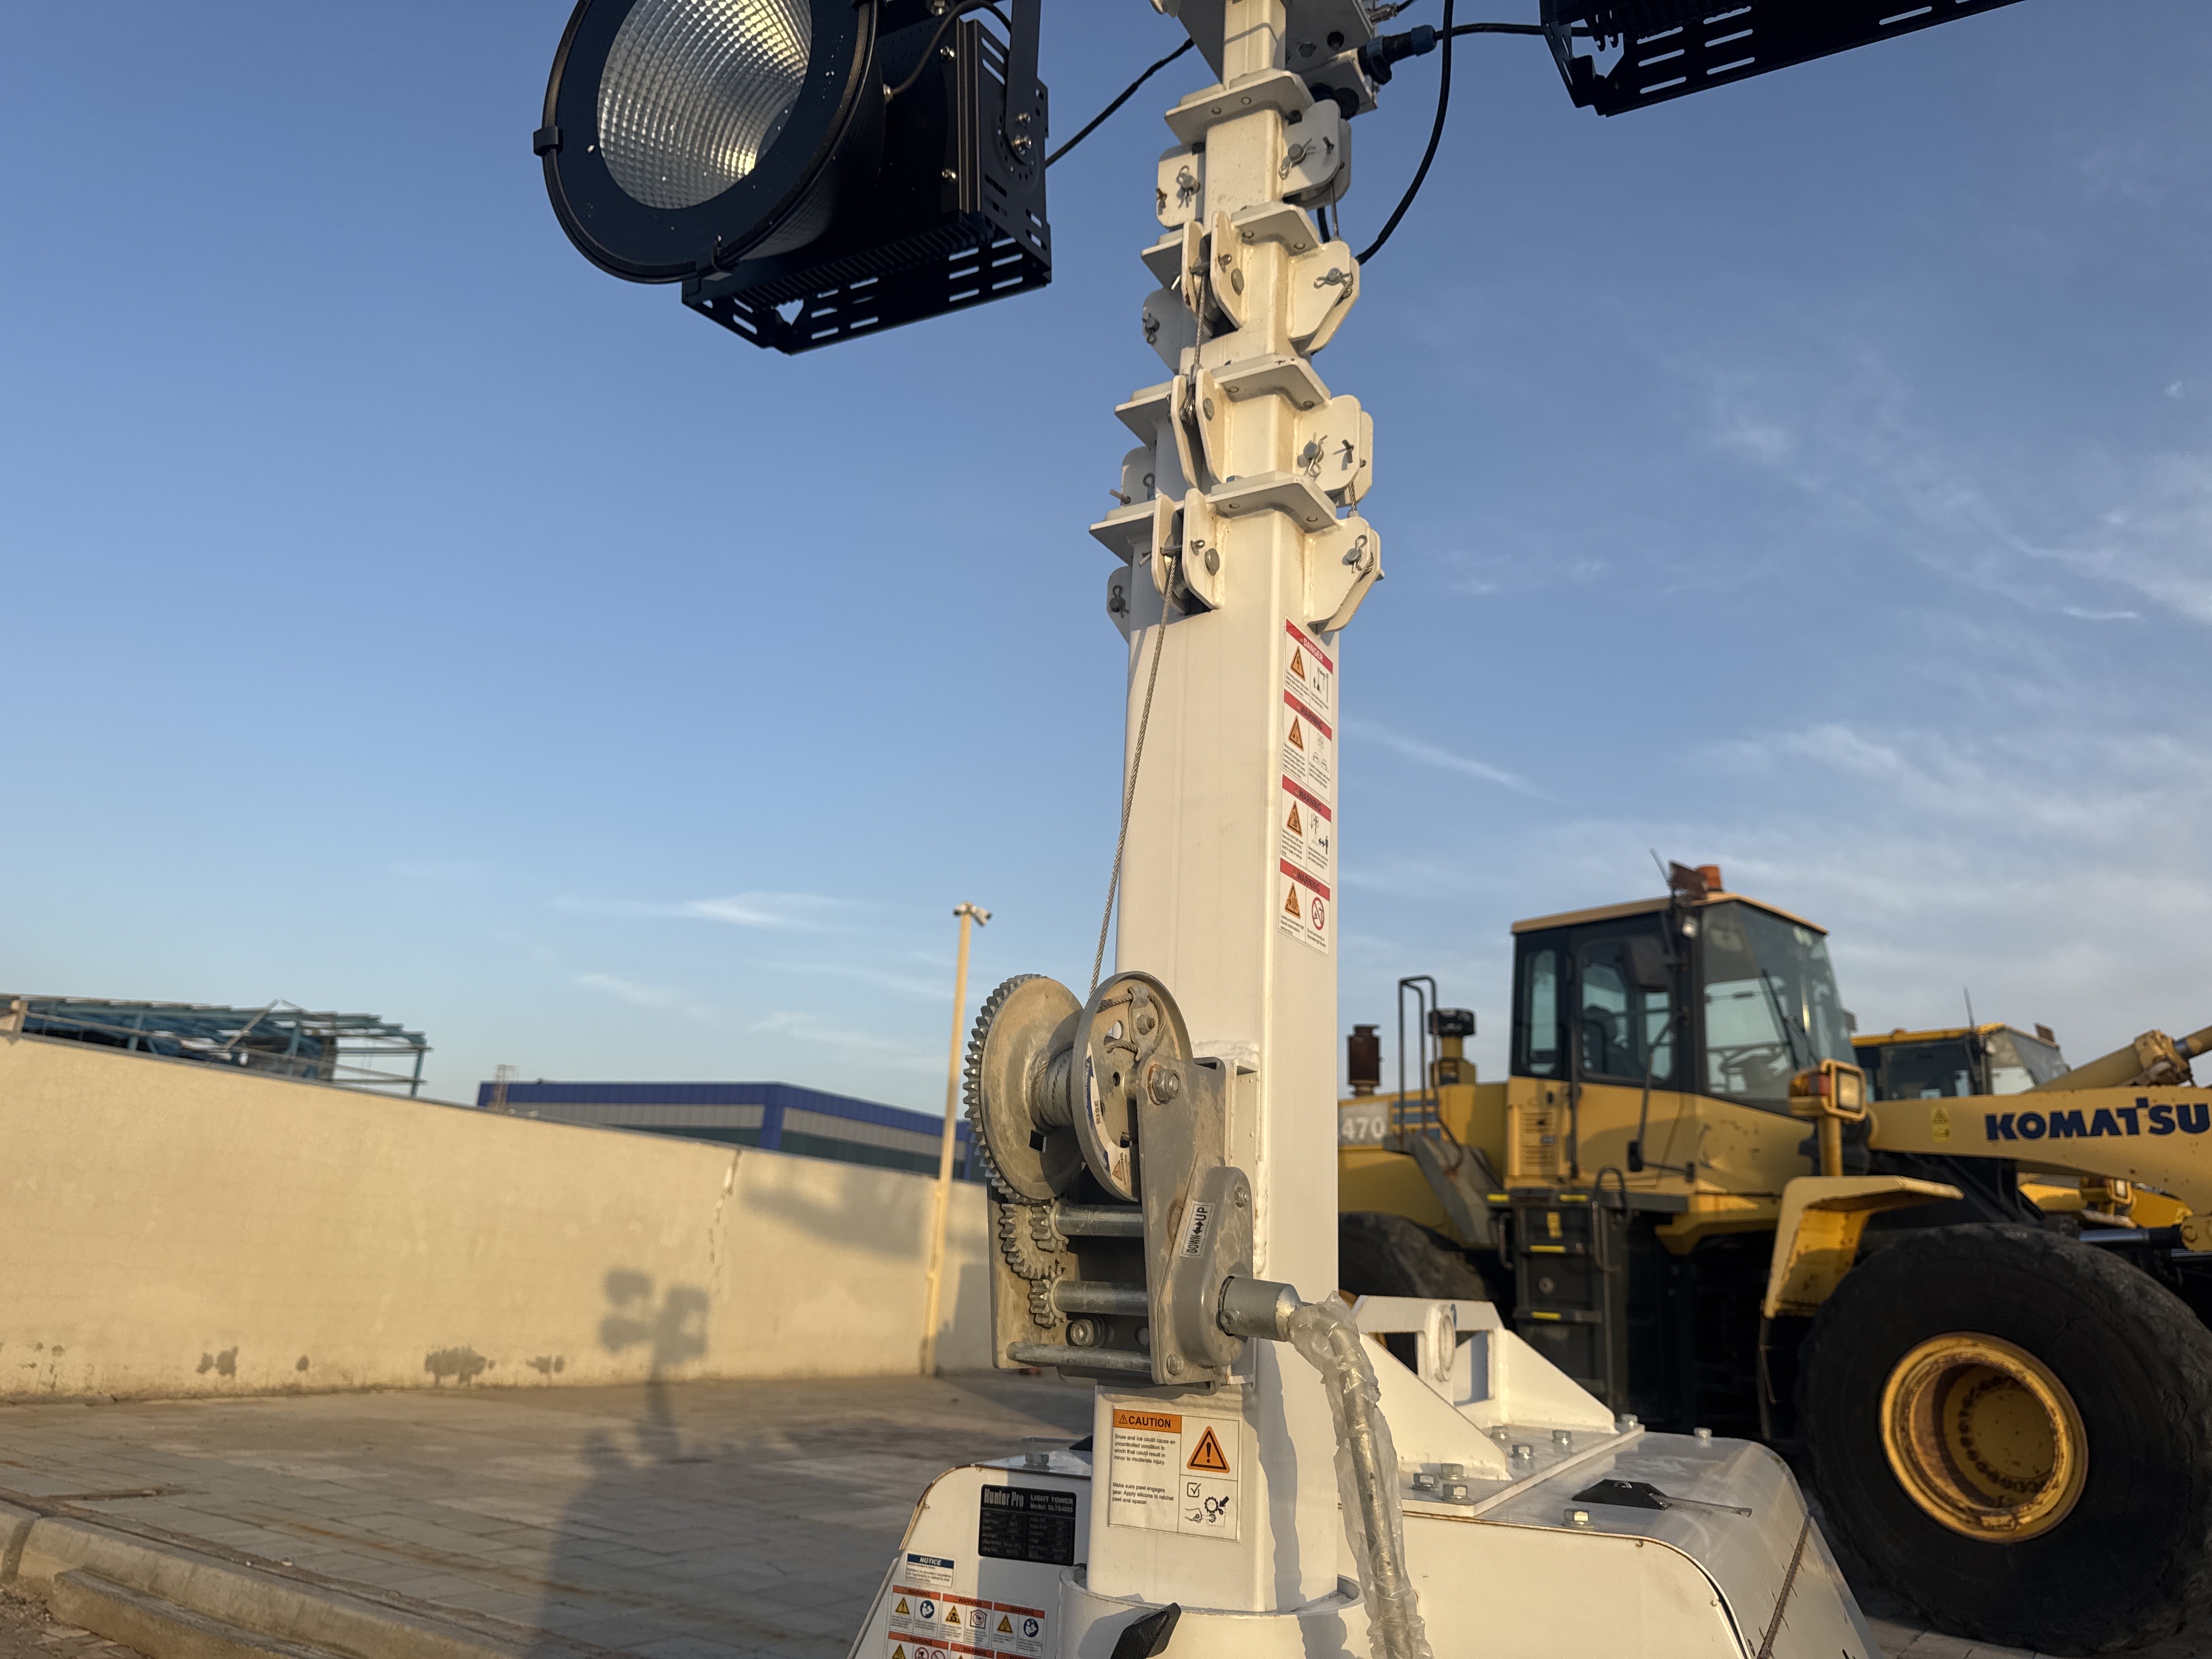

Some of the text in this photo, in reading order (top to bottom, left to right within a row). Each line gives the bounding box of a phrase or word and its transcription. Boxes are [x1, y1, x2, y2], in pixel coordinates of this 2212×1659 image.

[1304, 637, 1323, 663] DANGER
[1301, 706, 1323, 730] WARNING
[1299, 788, 1322, 813] WARNING
[1296, 872, 1320, 893] WARNING
[1341, 1116, 1386, 1141] 470
[1984, 1097, 2210, 1141] KOMATSU
[1186, 1207, 1208, 1253] DOWN UP
[1128, 1416, 1171, 1429] CAUTION
[984, 1488, 1024, 1508] Hunter Pro
[1030, 1494, 1074, 1504] LIGHT TOWER
[919, 1556, 942, 1566] NOTICE
[907, 1588, 931, 1598] WARNING
[958, 1597, 982, 1607] WARNING
[910, 1637, 933, 1646] WARNING
[963, 1647, 987, 1656] WARNING
